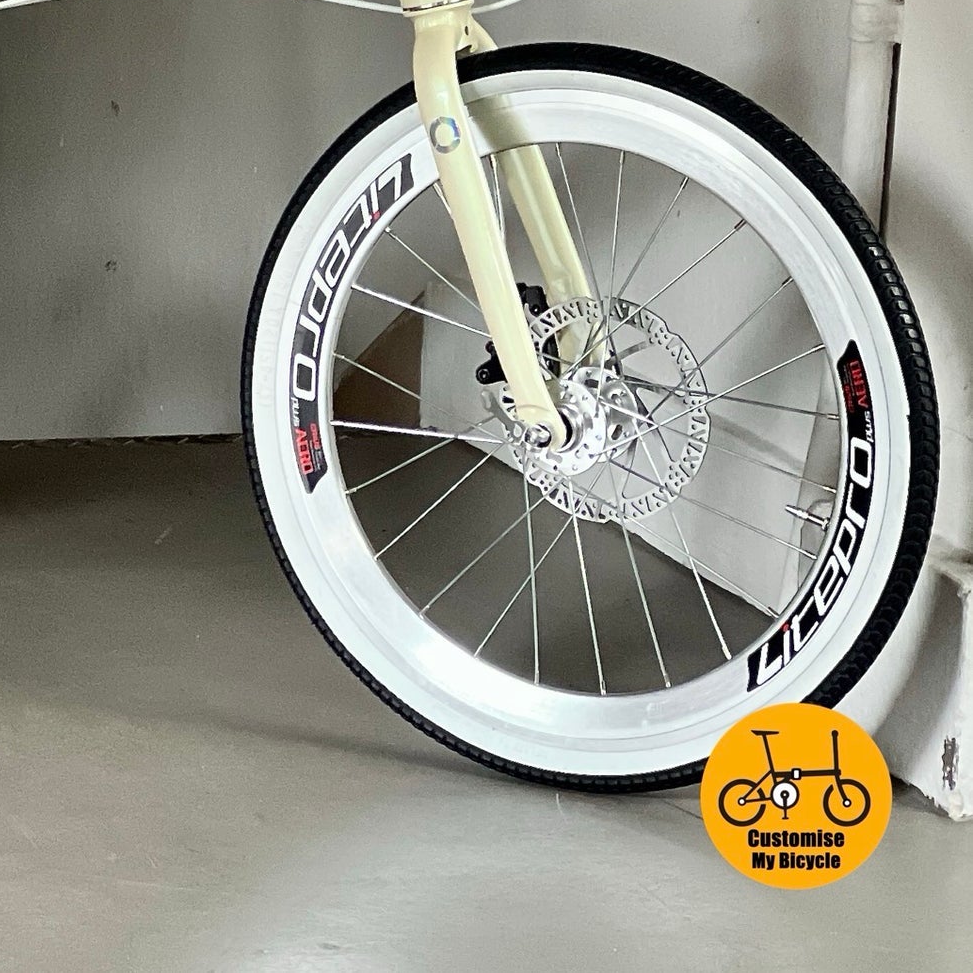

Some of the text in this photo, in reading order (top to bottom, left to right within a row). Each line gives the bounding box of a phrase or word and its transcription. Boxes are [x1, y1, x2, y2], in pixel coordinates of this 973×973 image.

[291, 160, 403, 402] Litepro
[295, 428, 314, 475] AERO
[757, 436, 873, 686] Litepro
